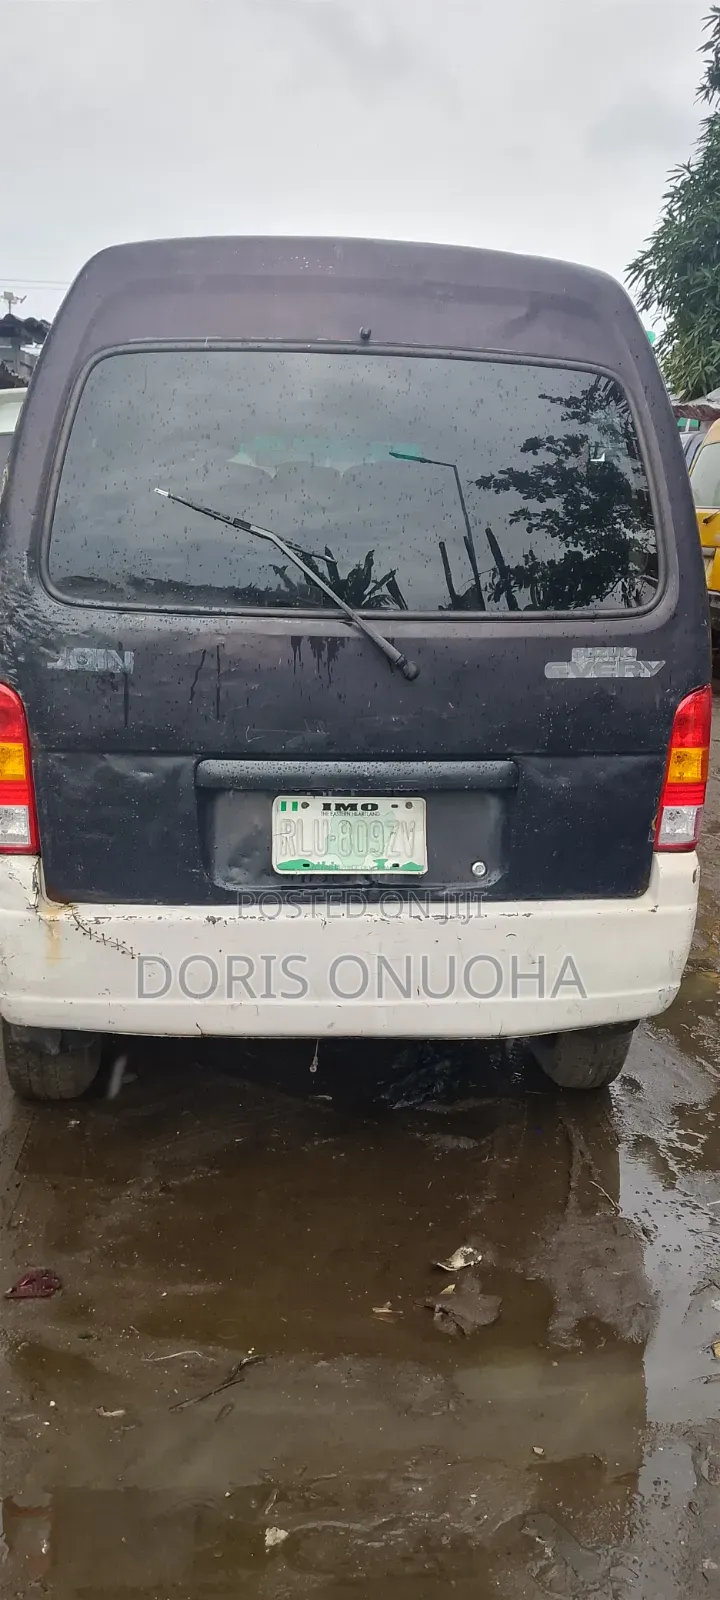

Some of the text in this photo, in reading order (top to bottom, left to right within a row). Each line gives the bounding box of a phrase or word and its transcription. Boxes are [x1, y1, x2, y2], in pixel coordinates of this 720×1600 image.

[47, 647, 134, 674] JOIN
[545, 660, 666, 678] EVERY
[321, 802, 379, 811] IMO
